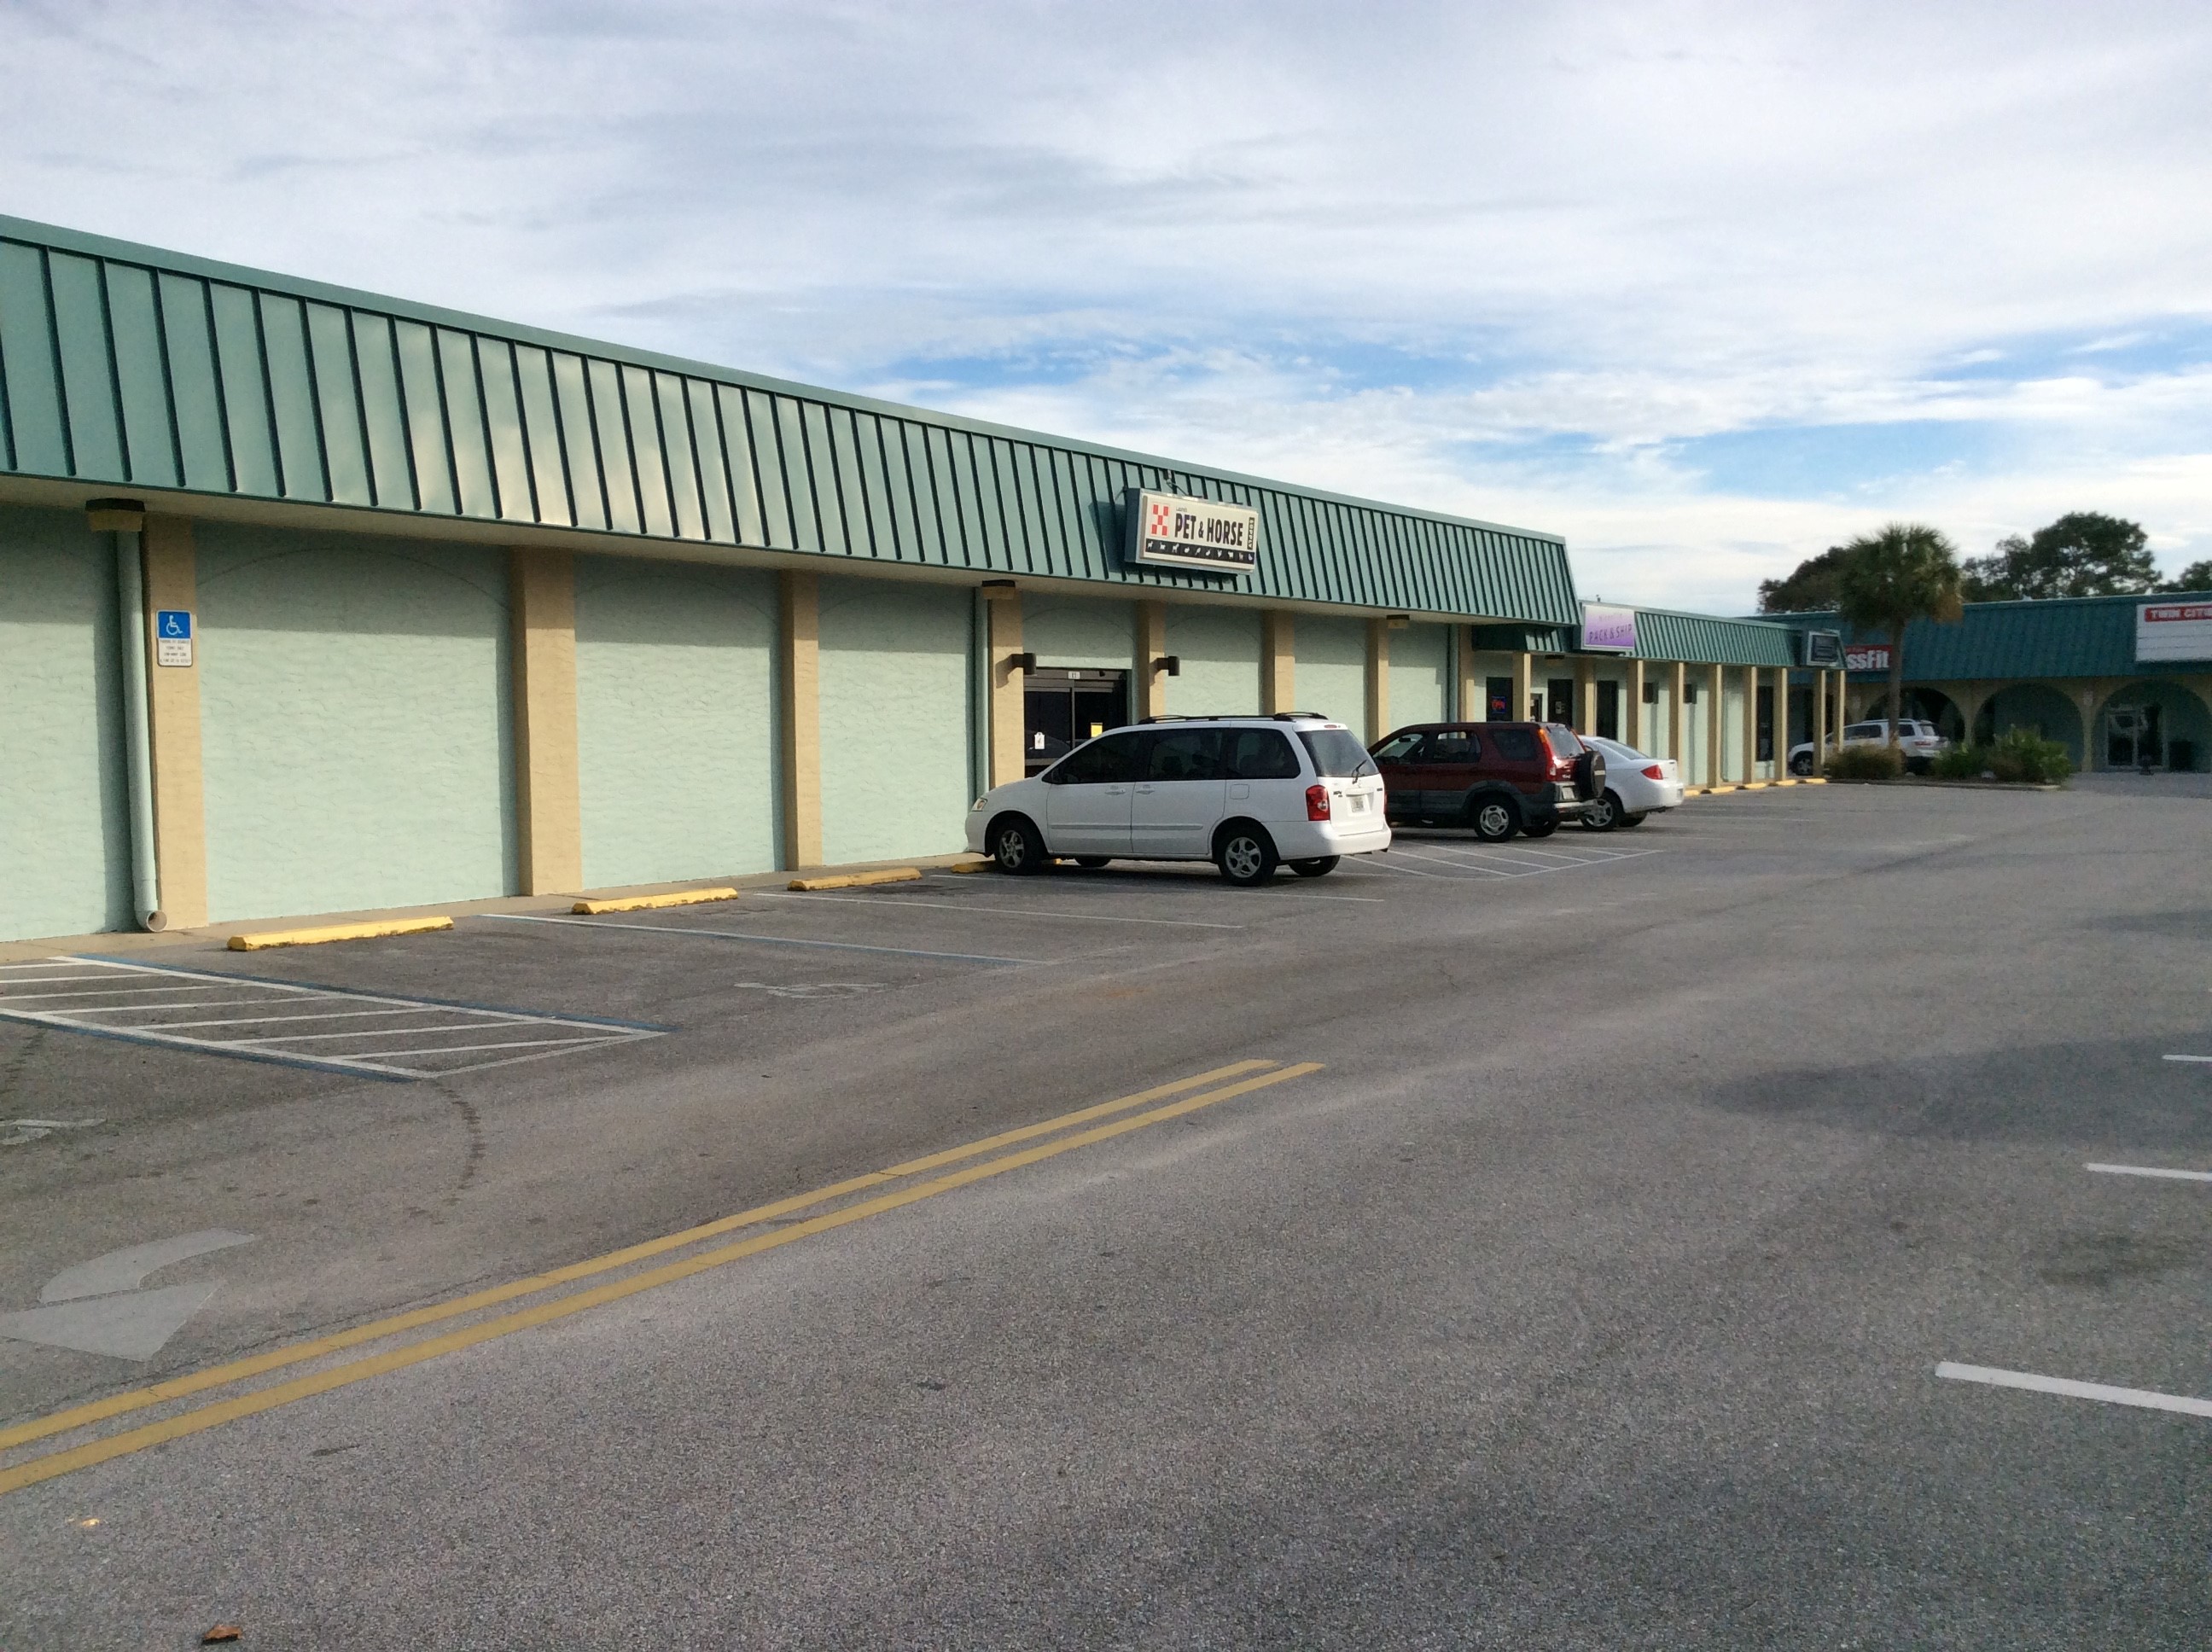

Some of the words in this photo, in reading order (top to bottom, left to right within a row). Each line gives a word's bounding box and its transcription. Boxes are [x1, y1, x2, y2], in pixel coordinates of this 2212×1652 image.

[1174, 513, 1196, 540] PET
[1198, 521, 1204, 539] &
[1207, 518, 1243, 546] HORSE
[2151, 608, 2180, 619] TWIN
[1589, 629, 1608, 643] PACK
[1615, 623, 1633, 638] SHIP
[1847, 649, 1889, 669] ssFit
